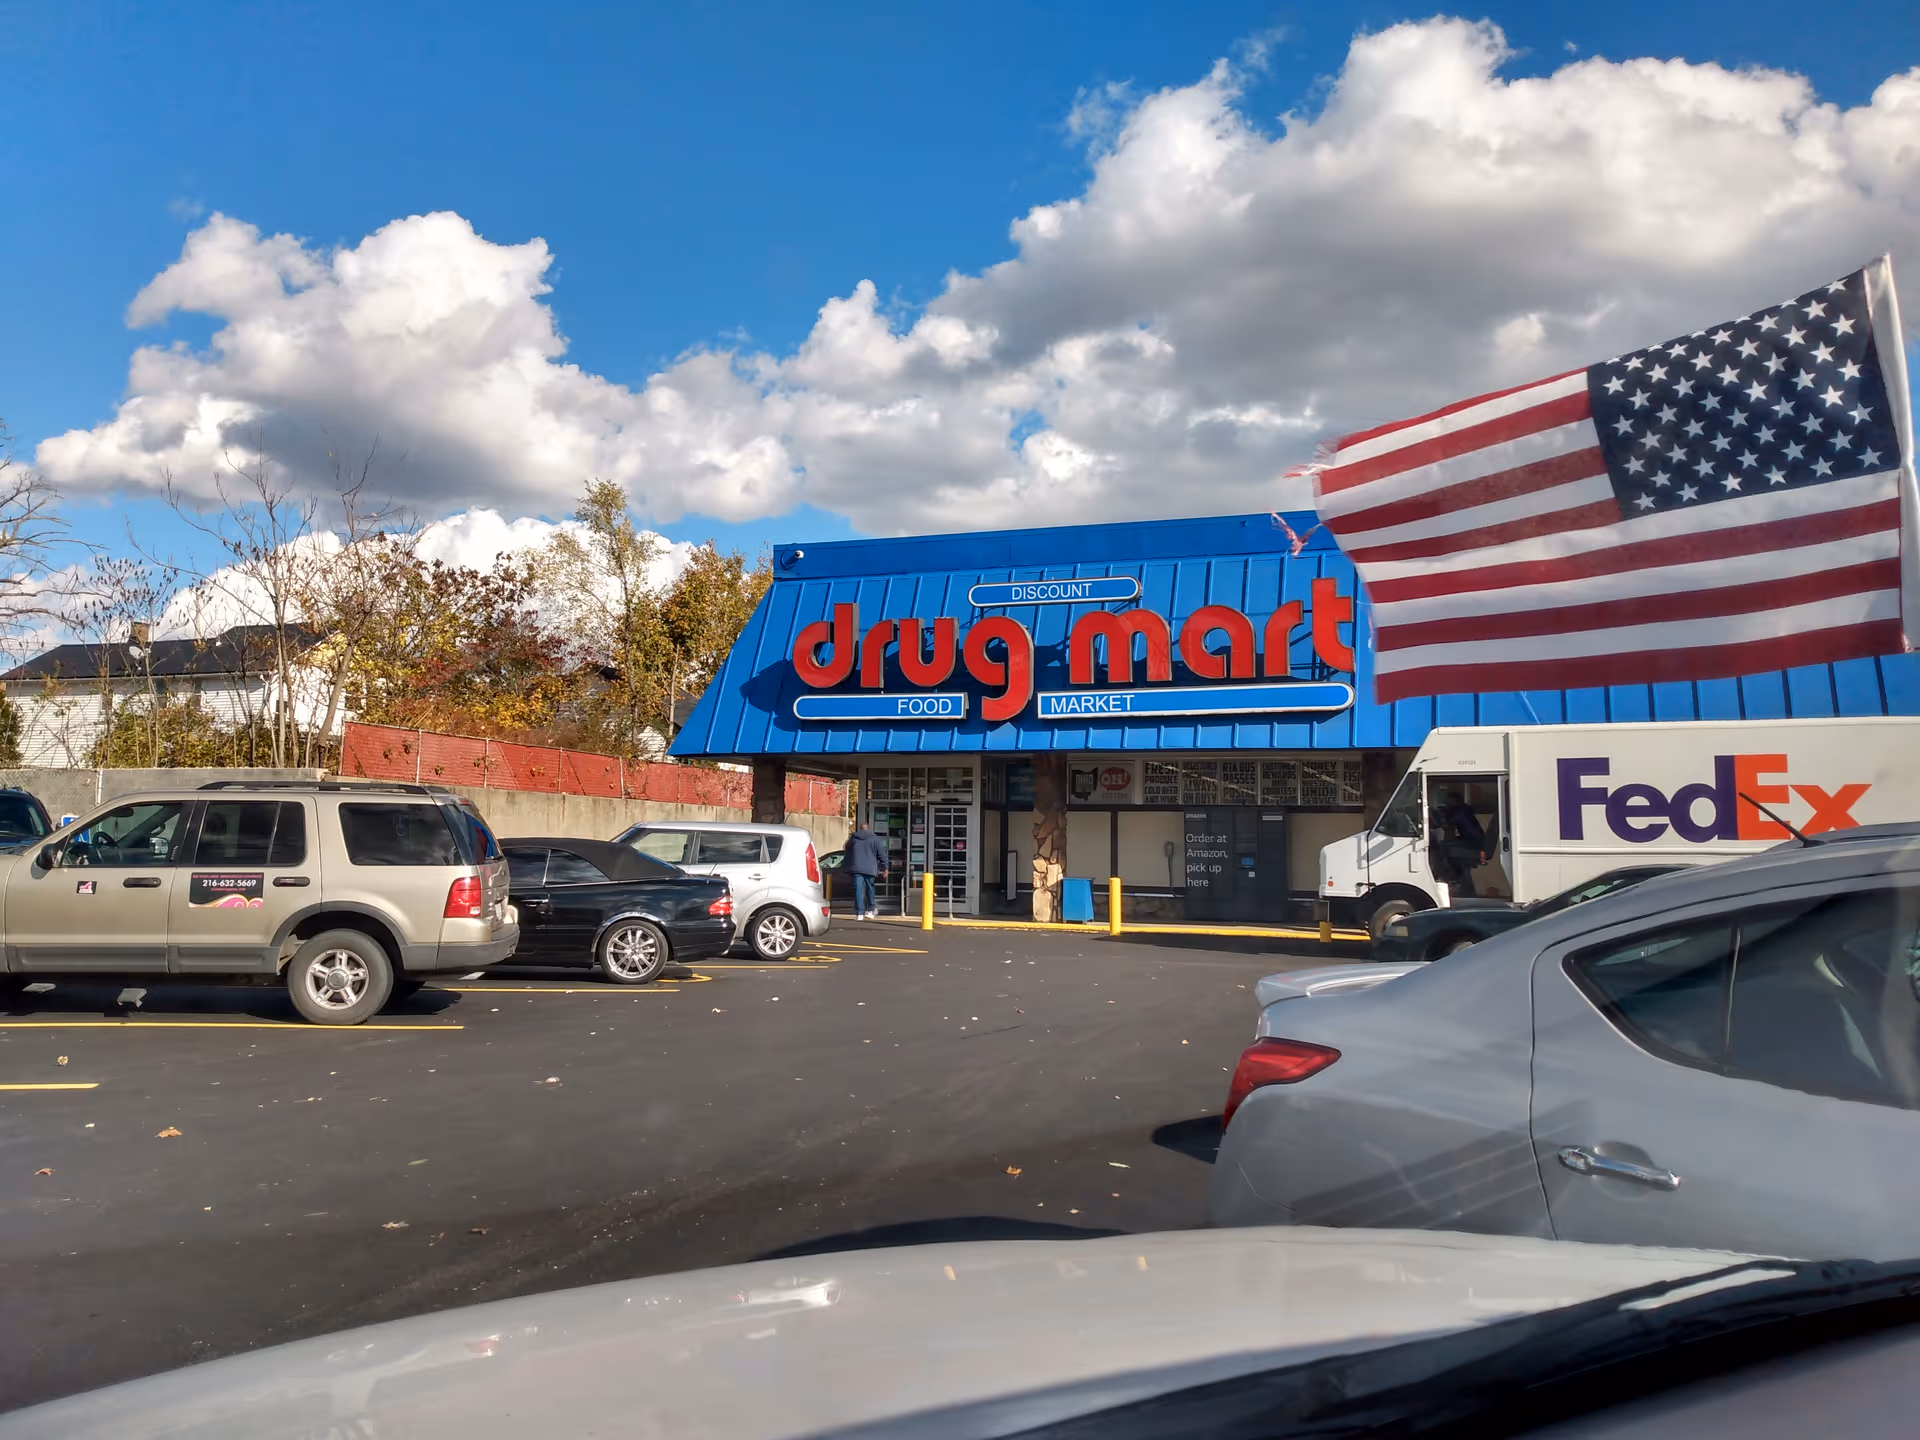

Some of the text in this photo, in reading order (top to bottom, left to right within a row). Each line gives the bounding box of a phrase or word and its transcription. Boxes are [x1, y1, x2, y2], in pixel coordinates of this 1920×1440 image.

[1011, 583, 1093, 600] DISCOUNT
[792, 577, 1355, 722] drug mart
[897, 698, 952, 715] FOOD
[1050, 694, 1135, 714] MARKET
[1145, 762, 1178, 775] FRESH
[1100, 772, 1128, 785] OH!
[1145, 775, 1178, 784] PRODUCE
[1223, 773, 1256, 785] PASSES
[1556, 753, 1872, 843] FedEx
[1185, 833, 1227, 843] Order at
[1187, 849, 1228, 859] Amazon,
[1187, 863, 1206, 873] pick
[202, 879, 257, 887] 216-632-5669
[1187, 877, 1209, 887] here
